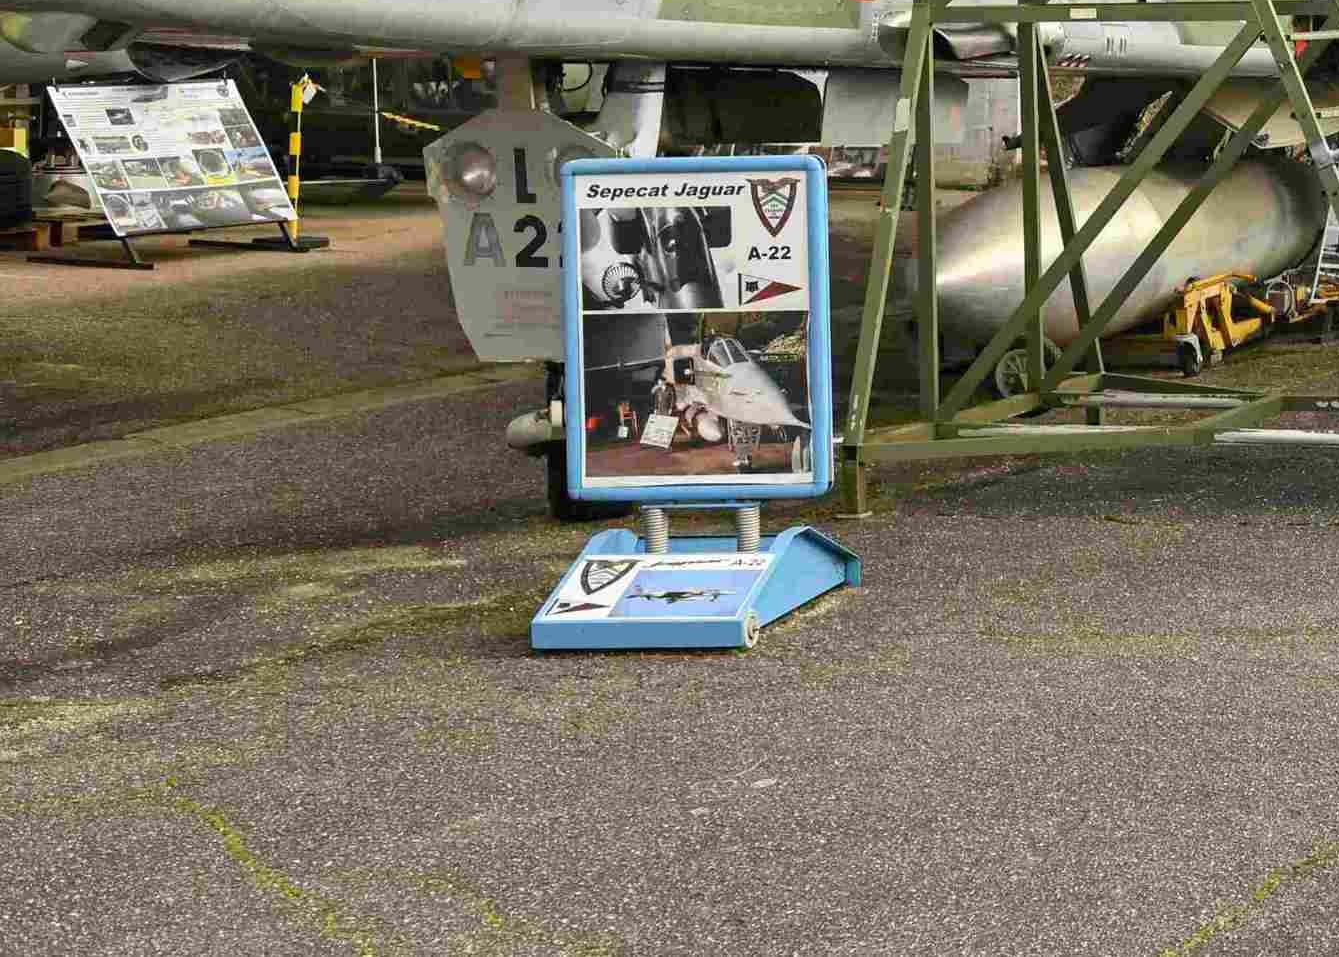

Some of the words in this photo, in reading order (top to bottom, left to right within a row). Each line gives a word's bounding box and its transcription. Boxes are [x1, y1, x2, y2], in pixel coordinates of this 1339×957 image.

[586, 183, 670, 201] Sepecat
[674, 182, 746, 200] Jaguar
[747, 245, 793, 261] A-22
